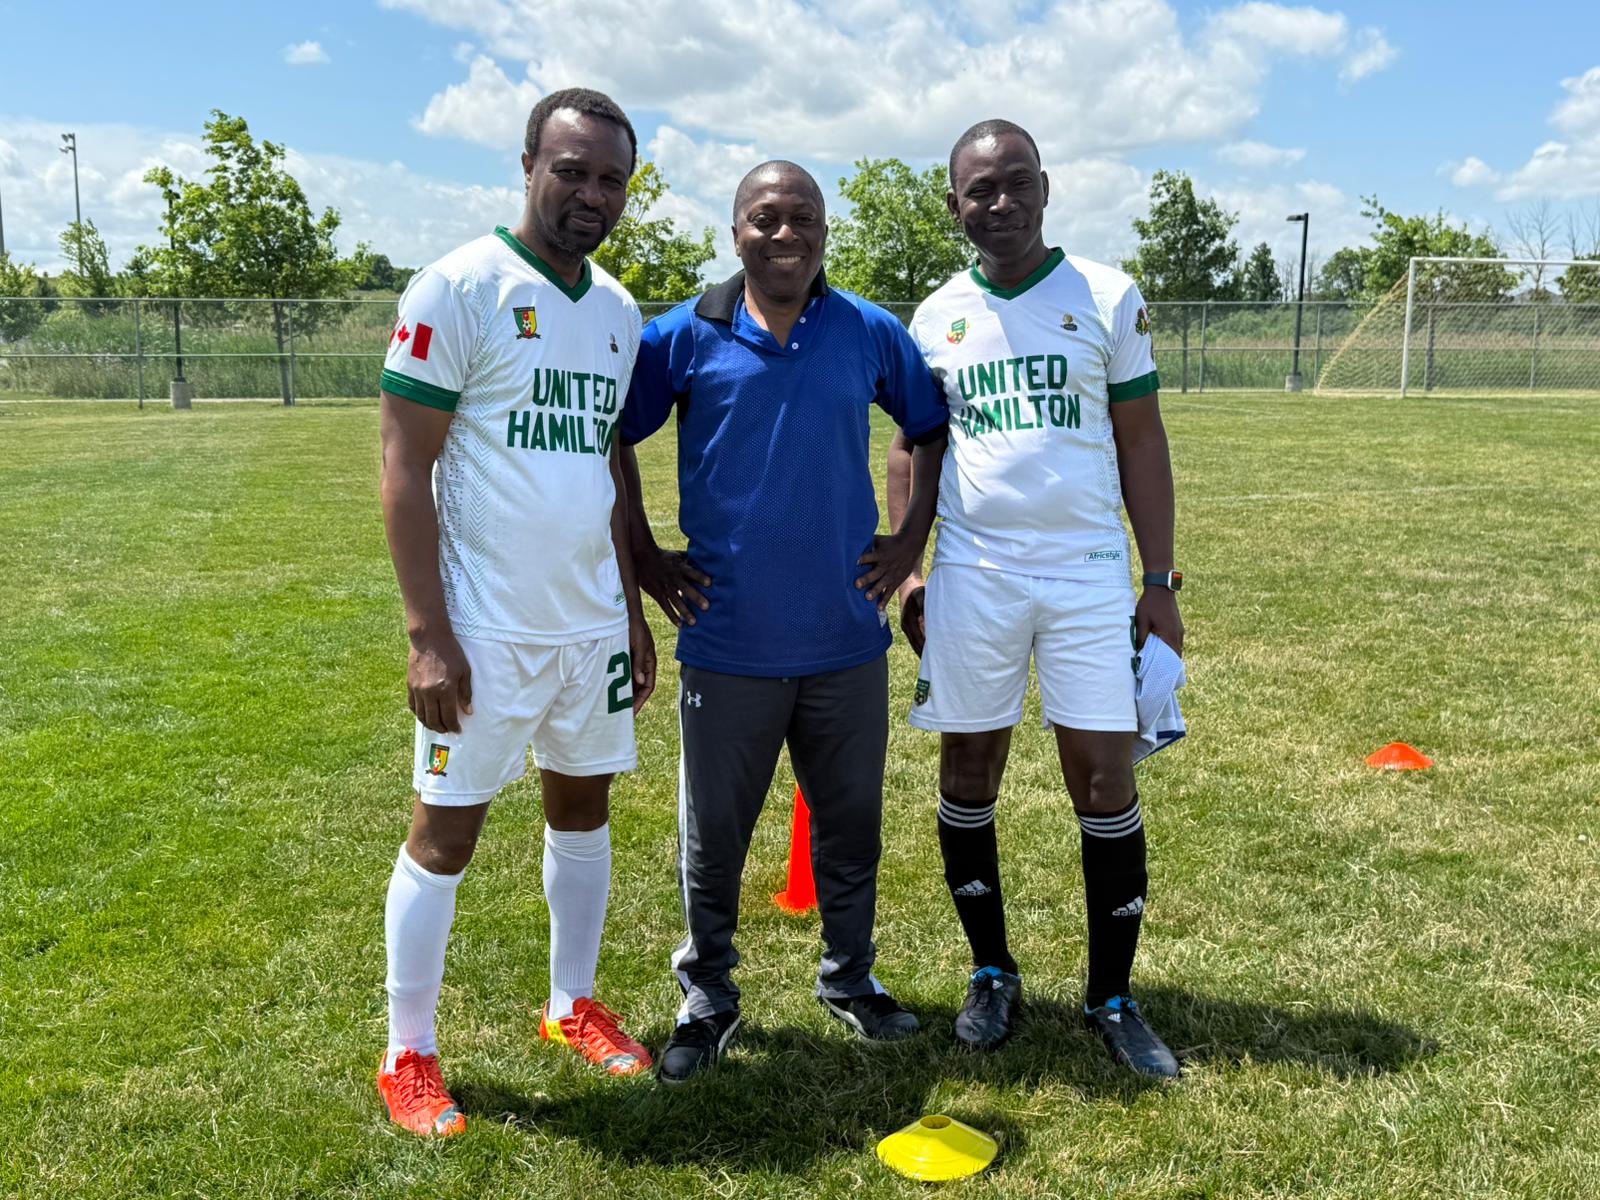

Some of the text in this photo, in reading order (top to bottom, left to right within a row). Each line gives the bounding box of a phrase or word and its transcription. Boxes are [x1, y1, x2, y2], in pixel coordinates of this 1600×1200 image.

[532, 368, 617, 415] UNITED
[957, 354, 1067, 401] UNITED
[507, 410, 616, 457] HAMILO
[960, 394, 1081, 439] HAMILTON
[607, 651, 633, 714] 2
